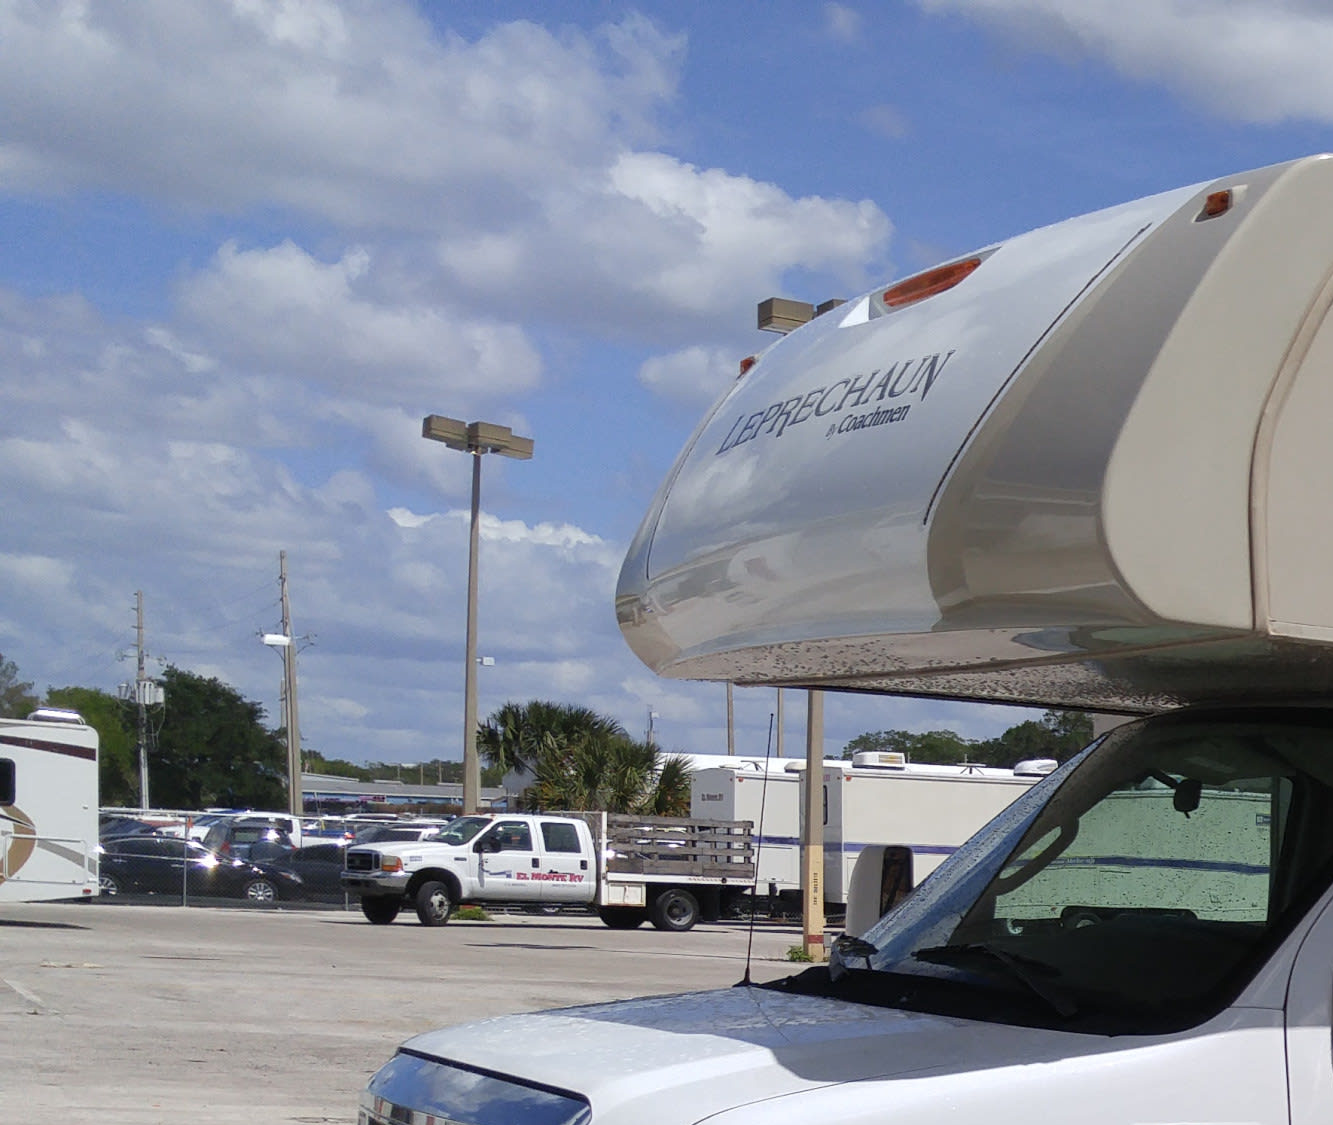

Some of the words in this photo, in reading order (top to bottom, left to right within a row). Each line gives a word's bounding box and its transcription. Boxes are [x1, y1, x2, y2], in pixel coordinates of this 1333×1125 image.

[715, 349, 956, 456] LEPRECHAUN
[837, 404, 911, 435] Coachmen
[531, 872, 568, 882] MONTE
